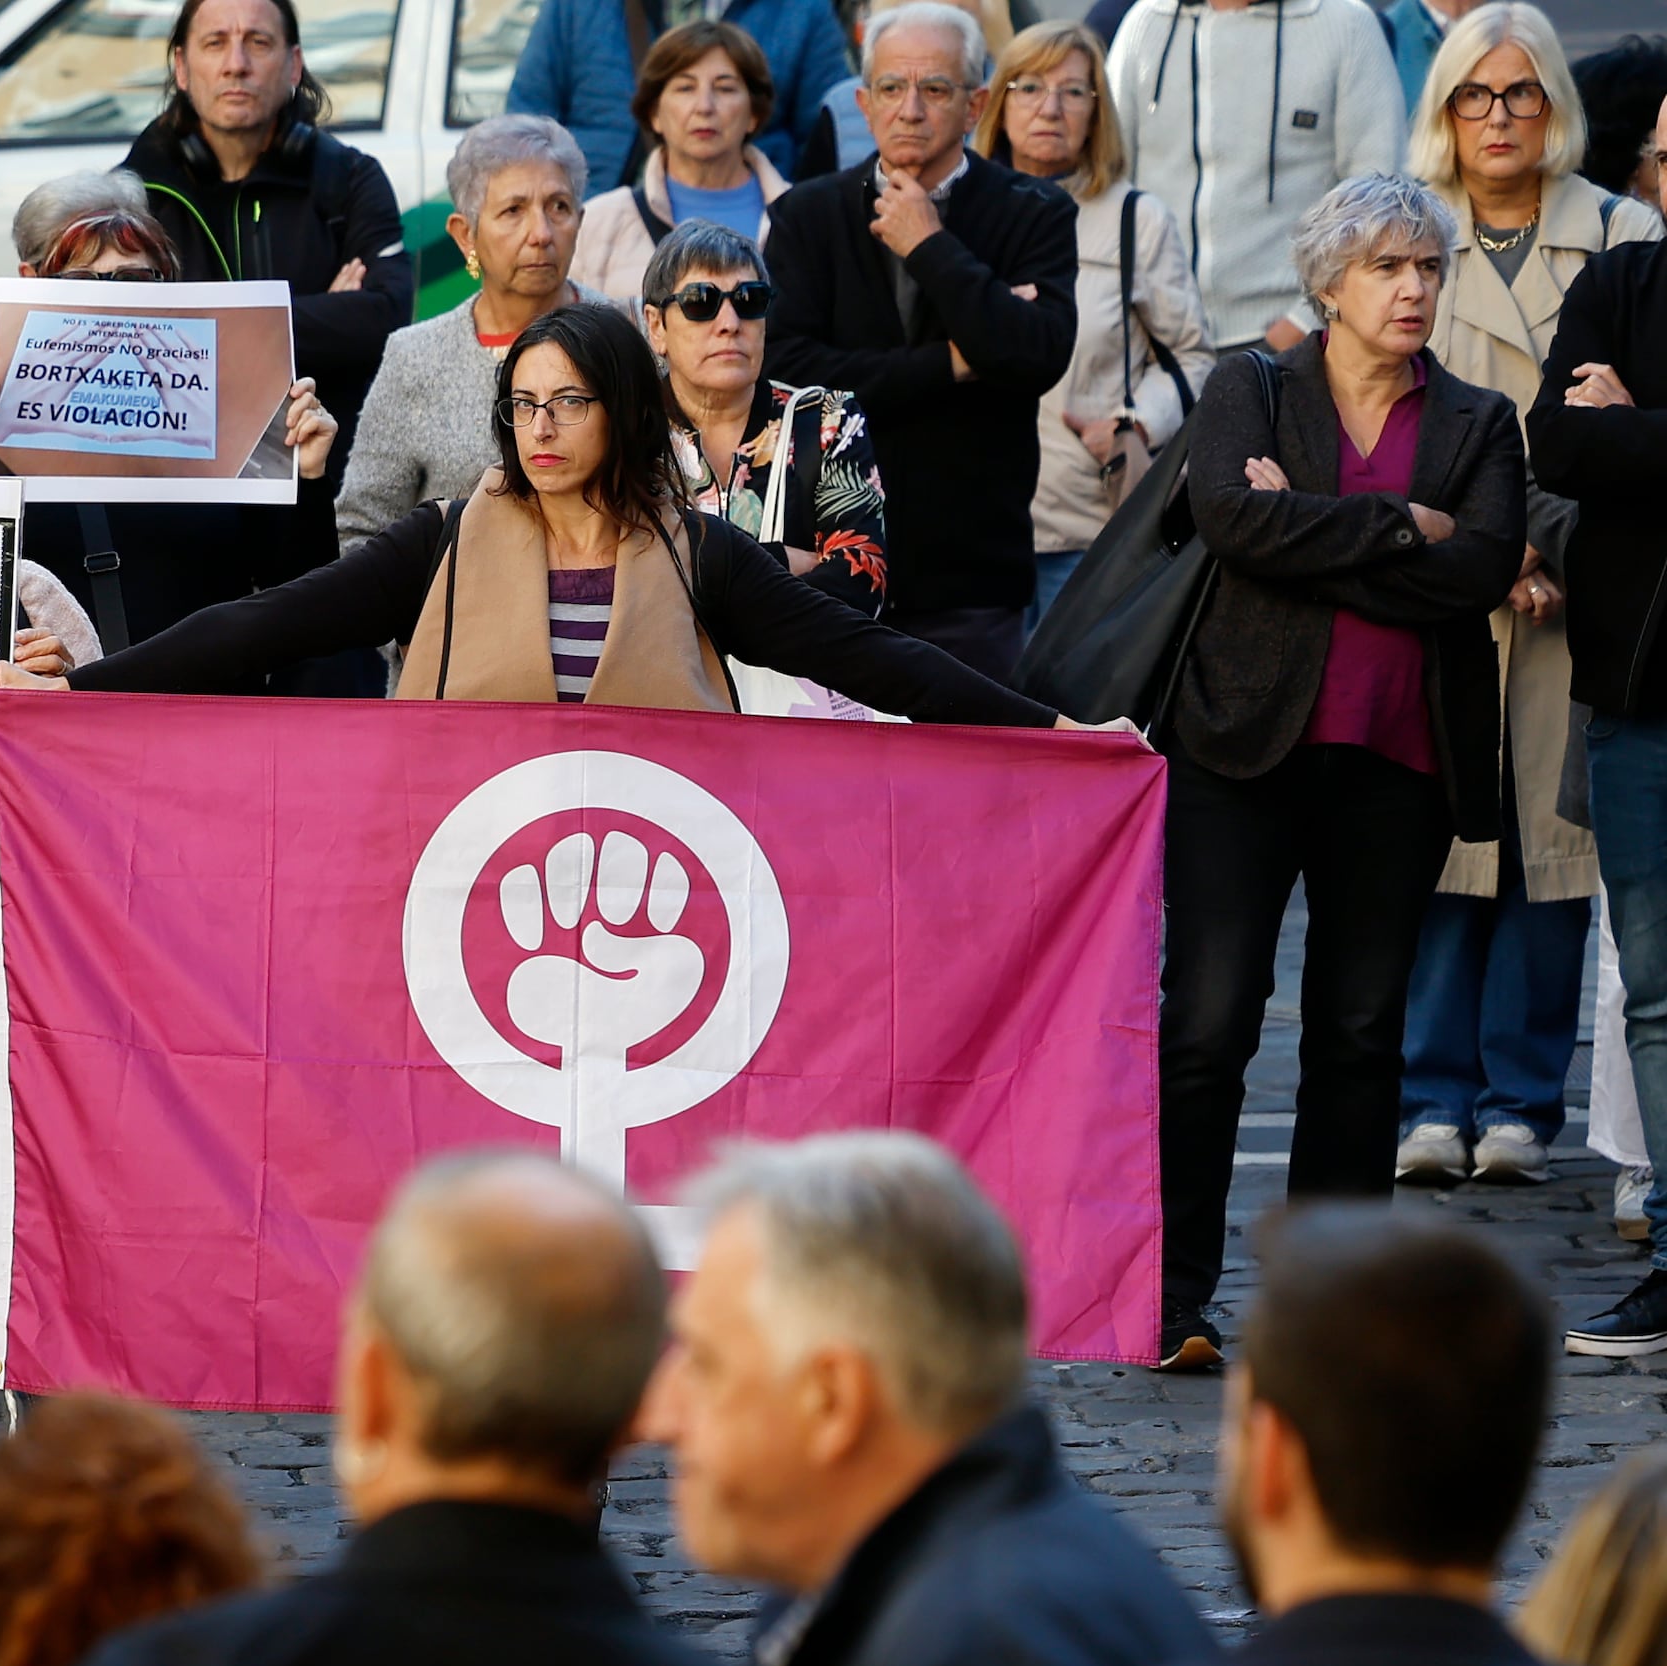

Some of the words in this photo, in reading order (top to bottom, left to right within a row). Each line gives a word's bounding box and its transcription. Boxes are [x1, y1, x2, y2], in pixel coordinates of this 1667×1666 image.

[26, 338, 114, 353] Eufemismos
[120, 345, 142, 355] NO
[147, 347, 208, 359] gracias!!
[16, 364, 163, 388] BORTXAKETA
[171, 373, 209, 391] DA.
[17, 402, 42, 420] ES
[50, 405, 187, 430] VIOLACIÓN!
